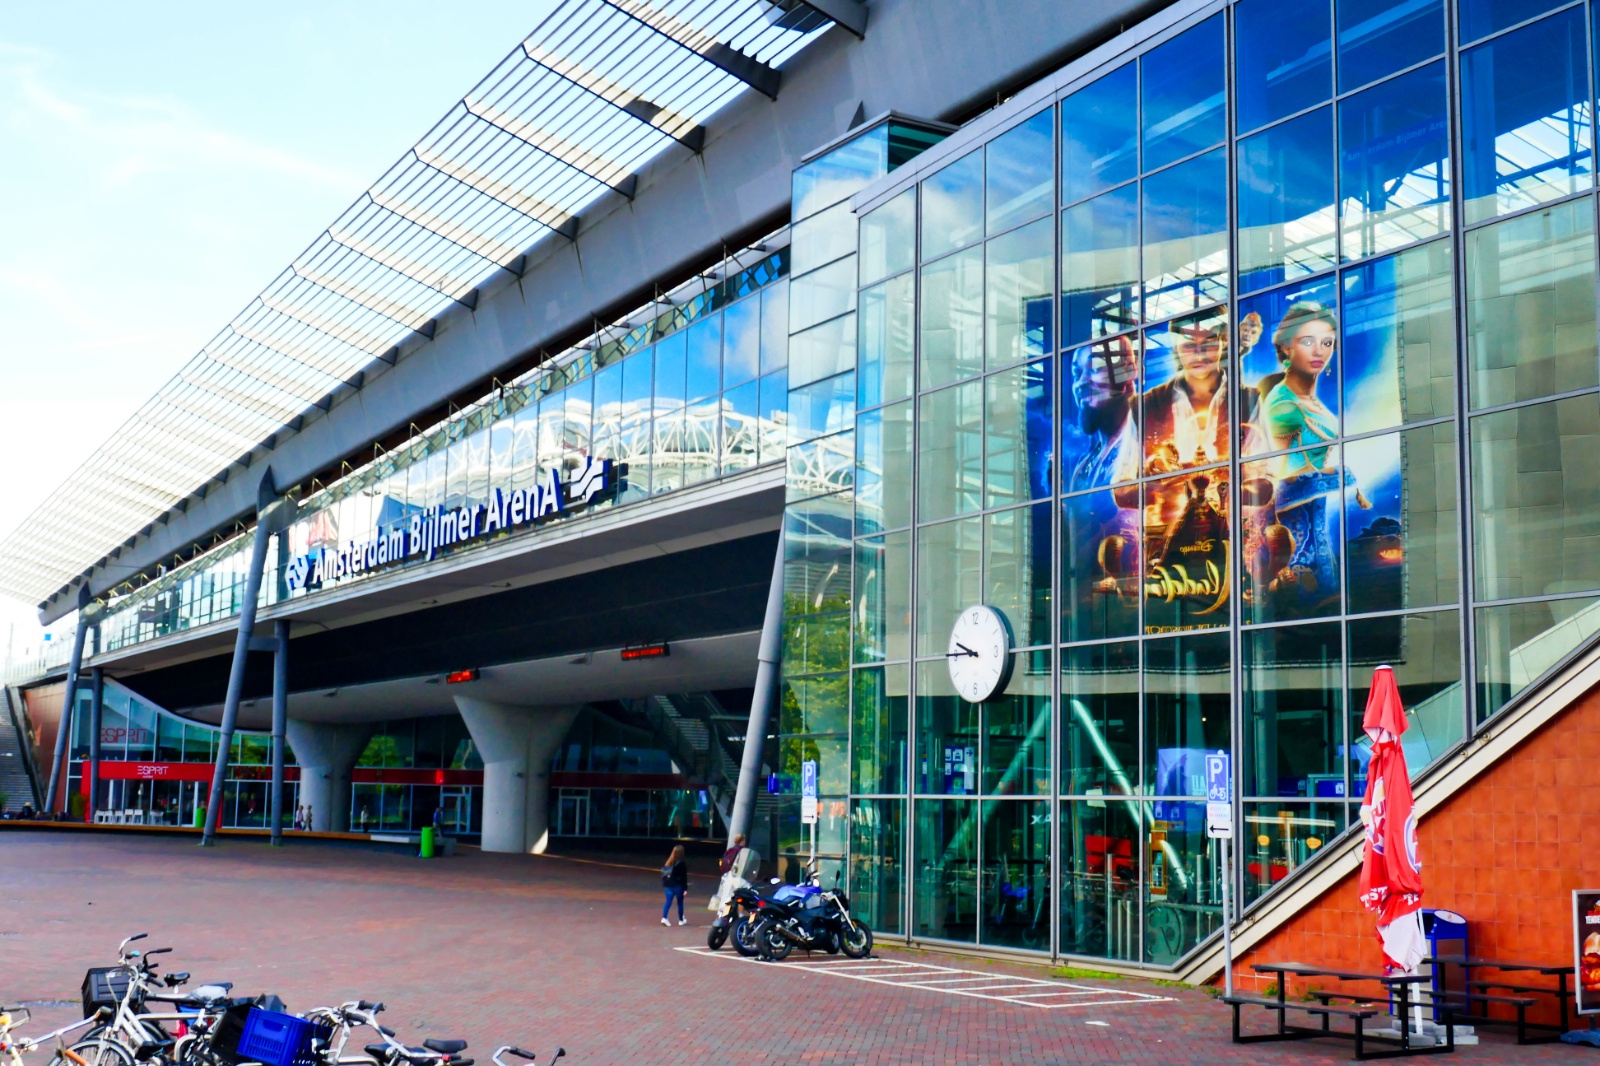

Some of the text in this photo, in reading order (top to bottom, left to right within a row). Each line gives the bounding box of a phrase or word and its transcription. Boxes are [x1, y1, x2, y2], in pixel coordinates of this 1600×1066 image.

[1347, 139, 1394, 162] Amerdam
[312, 468, 559, 584] Amsterdam Bijlmer ArenA
[972, 612, 979, 625] 12
[993, 645, 999, 658] 3
[973, 682, 978, 695] 6
[137, 765, 168, 775] ESPRIT
[805, 765, 813, 783] P
[1210, 758, 1223, 783] P
